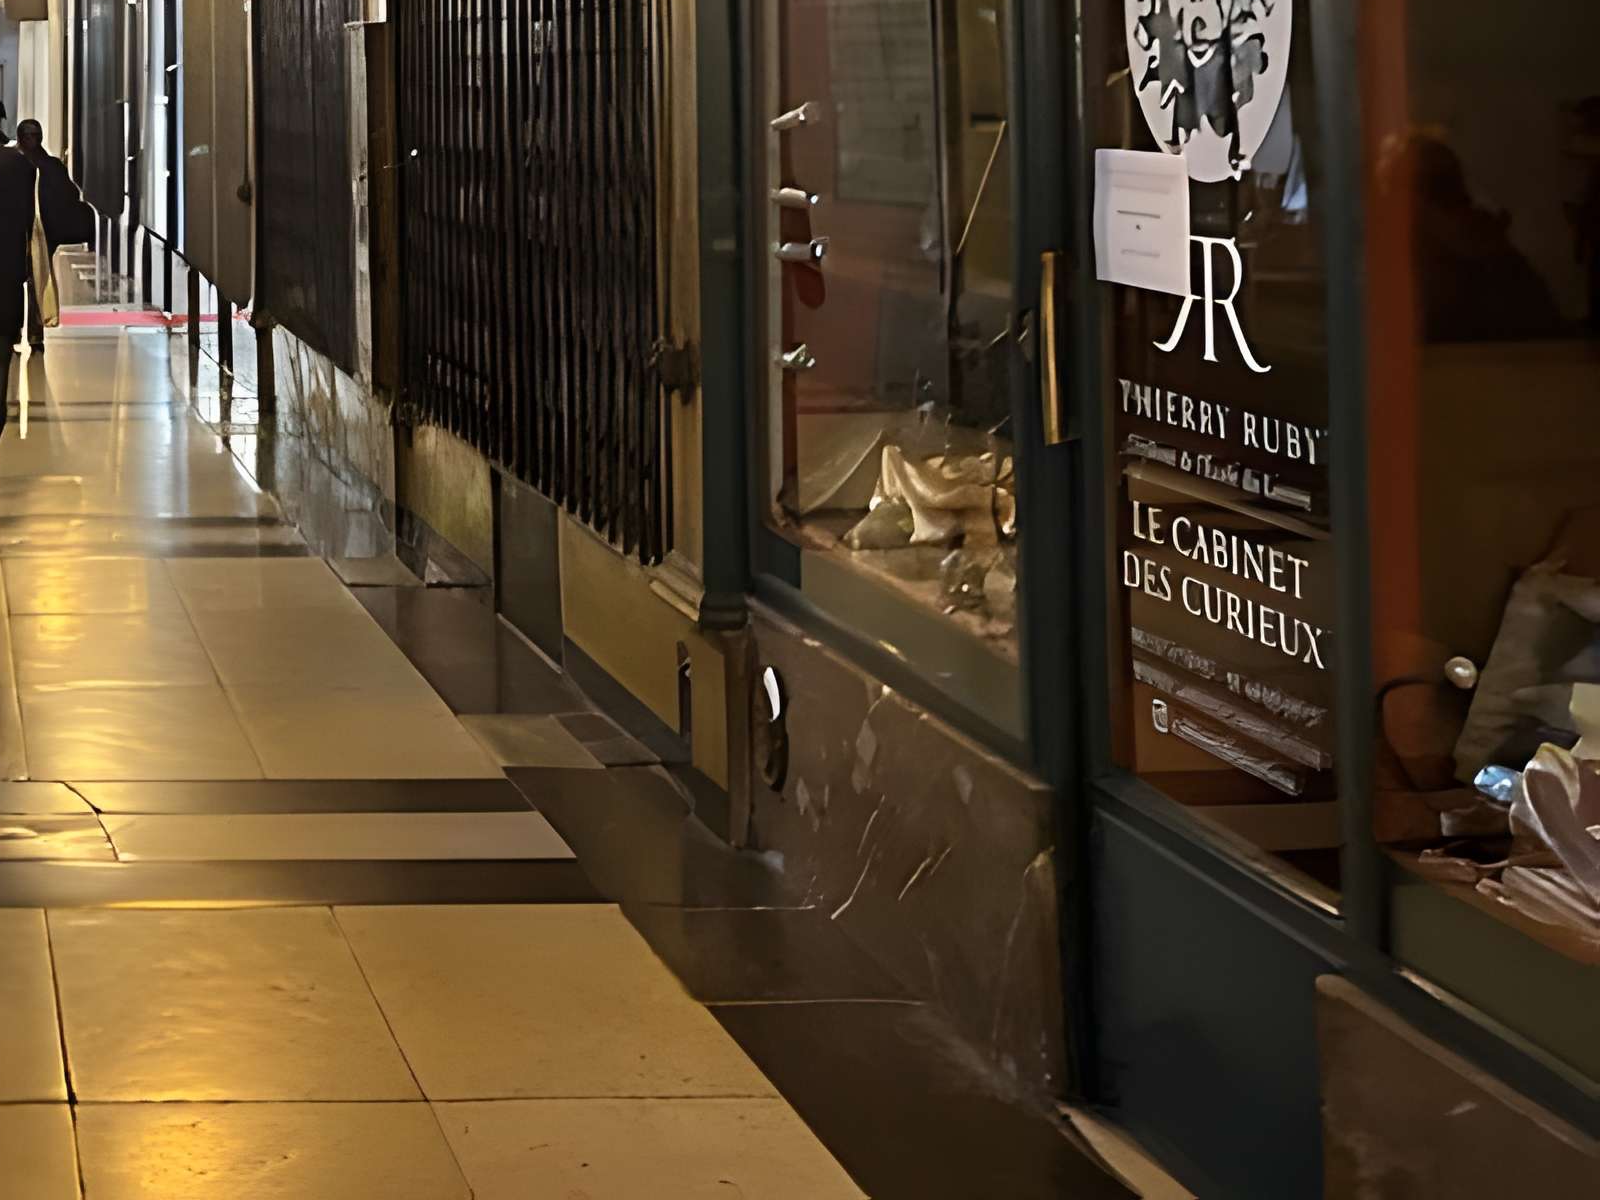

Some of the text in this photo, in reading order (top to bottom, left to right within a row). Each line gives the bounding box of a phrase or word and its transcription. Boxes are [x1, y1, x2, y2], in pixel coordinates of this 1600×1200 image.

[1118, 378, 1328, 465] THIERRY RUBY
[1132, 500, 1309, 600] LE CABINET
[1123, 550, 1325, 670] DES CURIEUX
